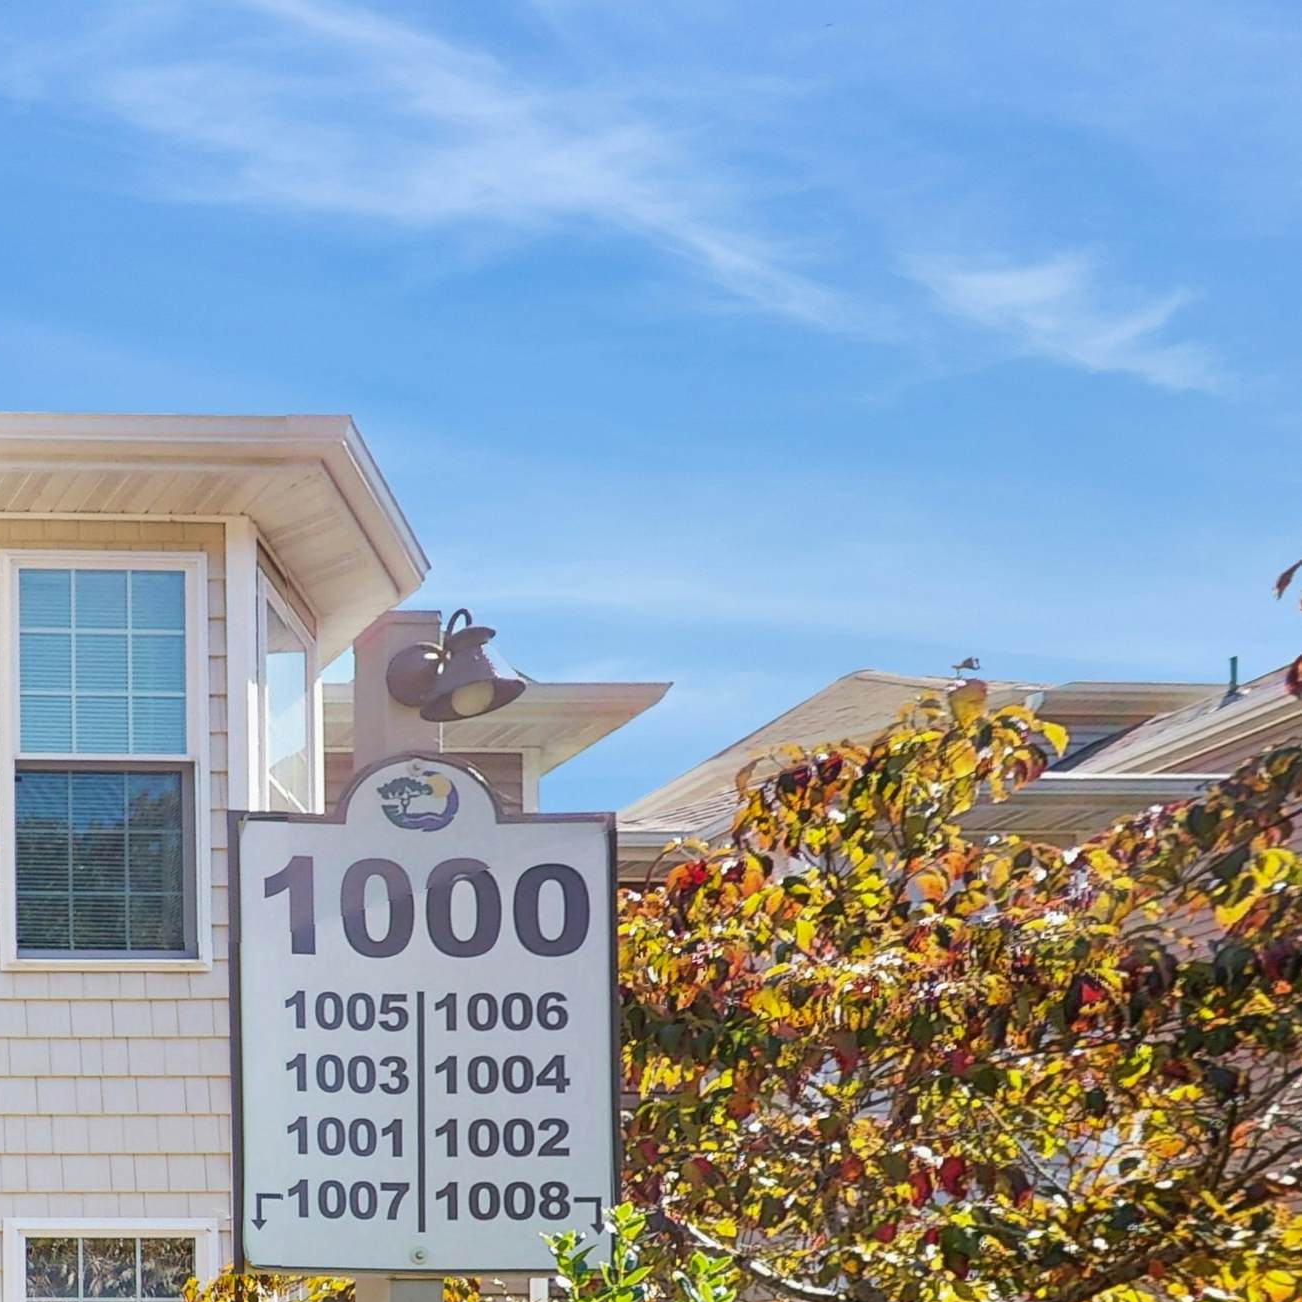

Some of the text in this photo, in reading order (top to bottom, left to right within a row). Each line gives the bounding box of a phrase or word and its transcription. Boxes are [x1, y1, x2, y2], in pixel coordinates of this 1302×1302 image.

[264, 855, 590, 958] 1000
[284, 990, 409, 1032] 1005
[434, 991, 569, 1032] 1006
[285, 1053, 409, 1095] 1003
[434, 1054, 571, 1095] 1004
[287, 1116, 404, 1158] 1001
[434, 1117, 570, 1158] 1002
[287, 1178, 410, 1220] 1007
[435, 1180, 571, 1221] 1008
